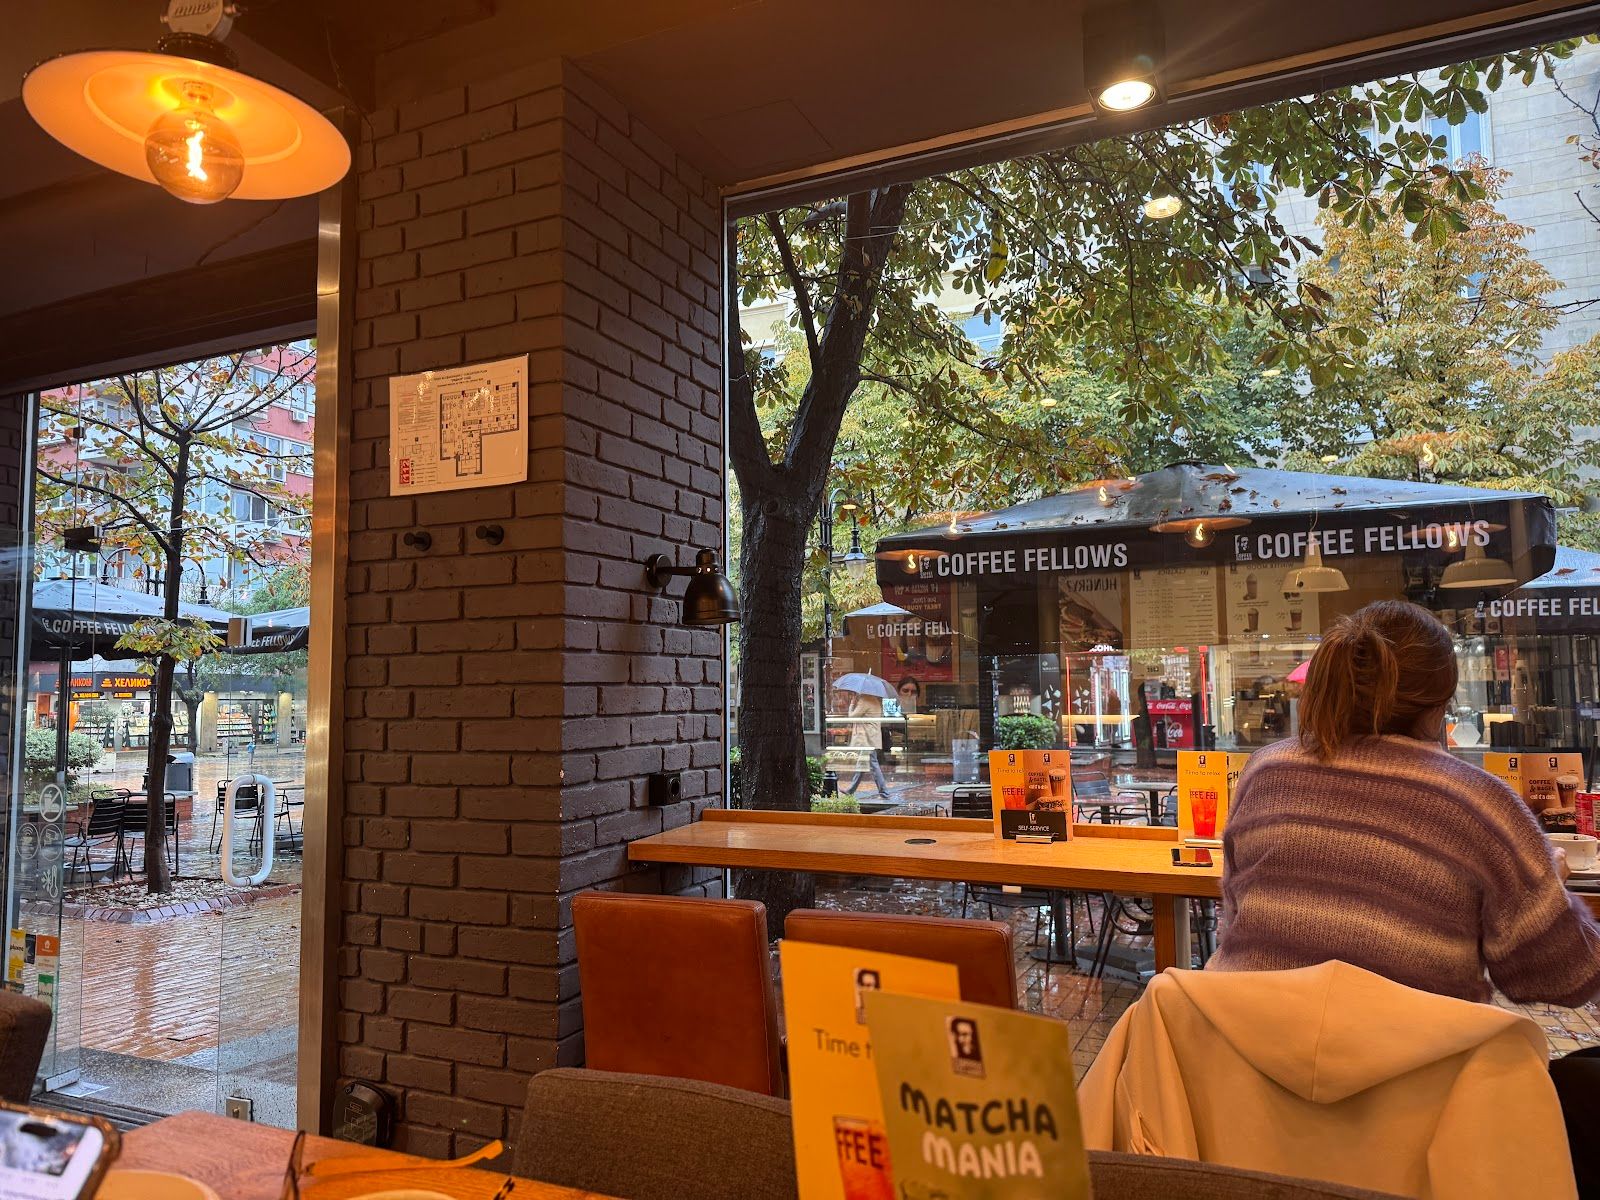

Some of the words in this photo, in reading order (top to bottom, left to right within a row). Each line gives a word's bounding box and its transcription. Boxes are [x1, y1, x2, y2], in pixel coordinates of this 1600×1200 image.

[1257, 529, 1354, 559] COFFEE
[1364, 520, 1490, 552] FELLOWS
[937, 550, 1016, 577] COFFEE
[1024, 543, 1128, 572] FELLOWS
[1490, 598, 1562, 617] COFFEE
[52, 619, 103, 635] COFFEE
[877, 622, 921, 638] COFFEE
[814, 1028, 860, 1058] Time
[901, 1081, 1058, 1140] MATCHA
[922, 1131, 1044, 1179] MANIA
